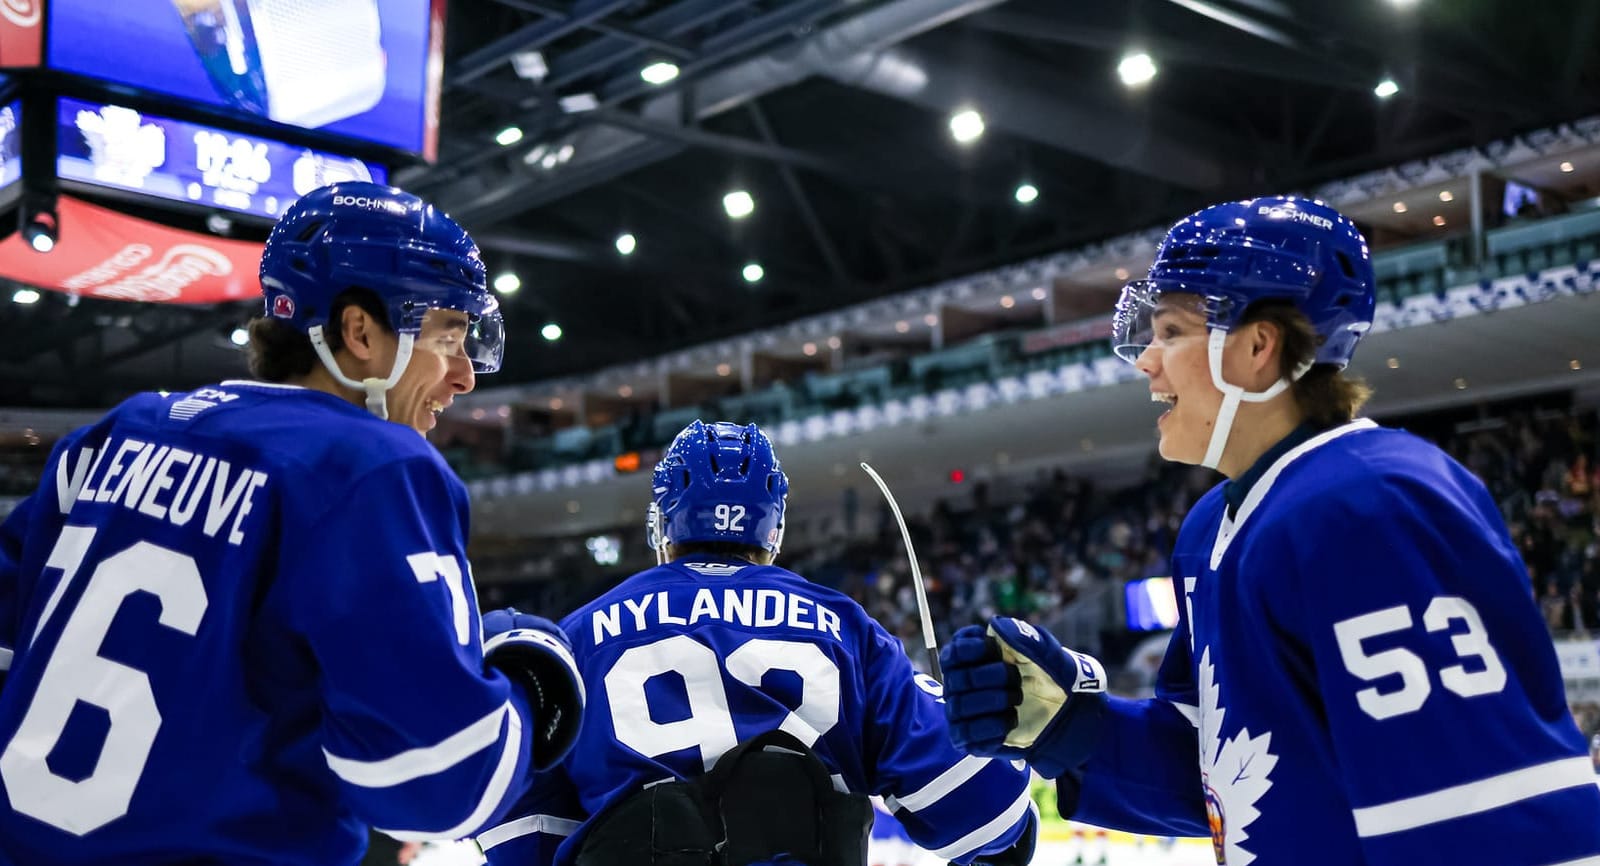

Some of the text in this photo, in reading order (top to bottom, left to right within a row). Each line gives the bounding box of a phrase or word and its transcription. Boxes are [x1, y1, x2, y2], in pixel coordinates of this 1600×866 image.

[333, 195, 407, 215] BOCHNR
[1258, 206, 1333, 230] BOCHNER
[56, 437, 268, 546] VLENEUVE
[714, 504, 746, 532] 92
[592, 589, 842, 645] NYLANDER
[0, 525, 209, 837] 76
[1333, 597, 1507, 721] 53
[604, 635, 840, 772] 92
